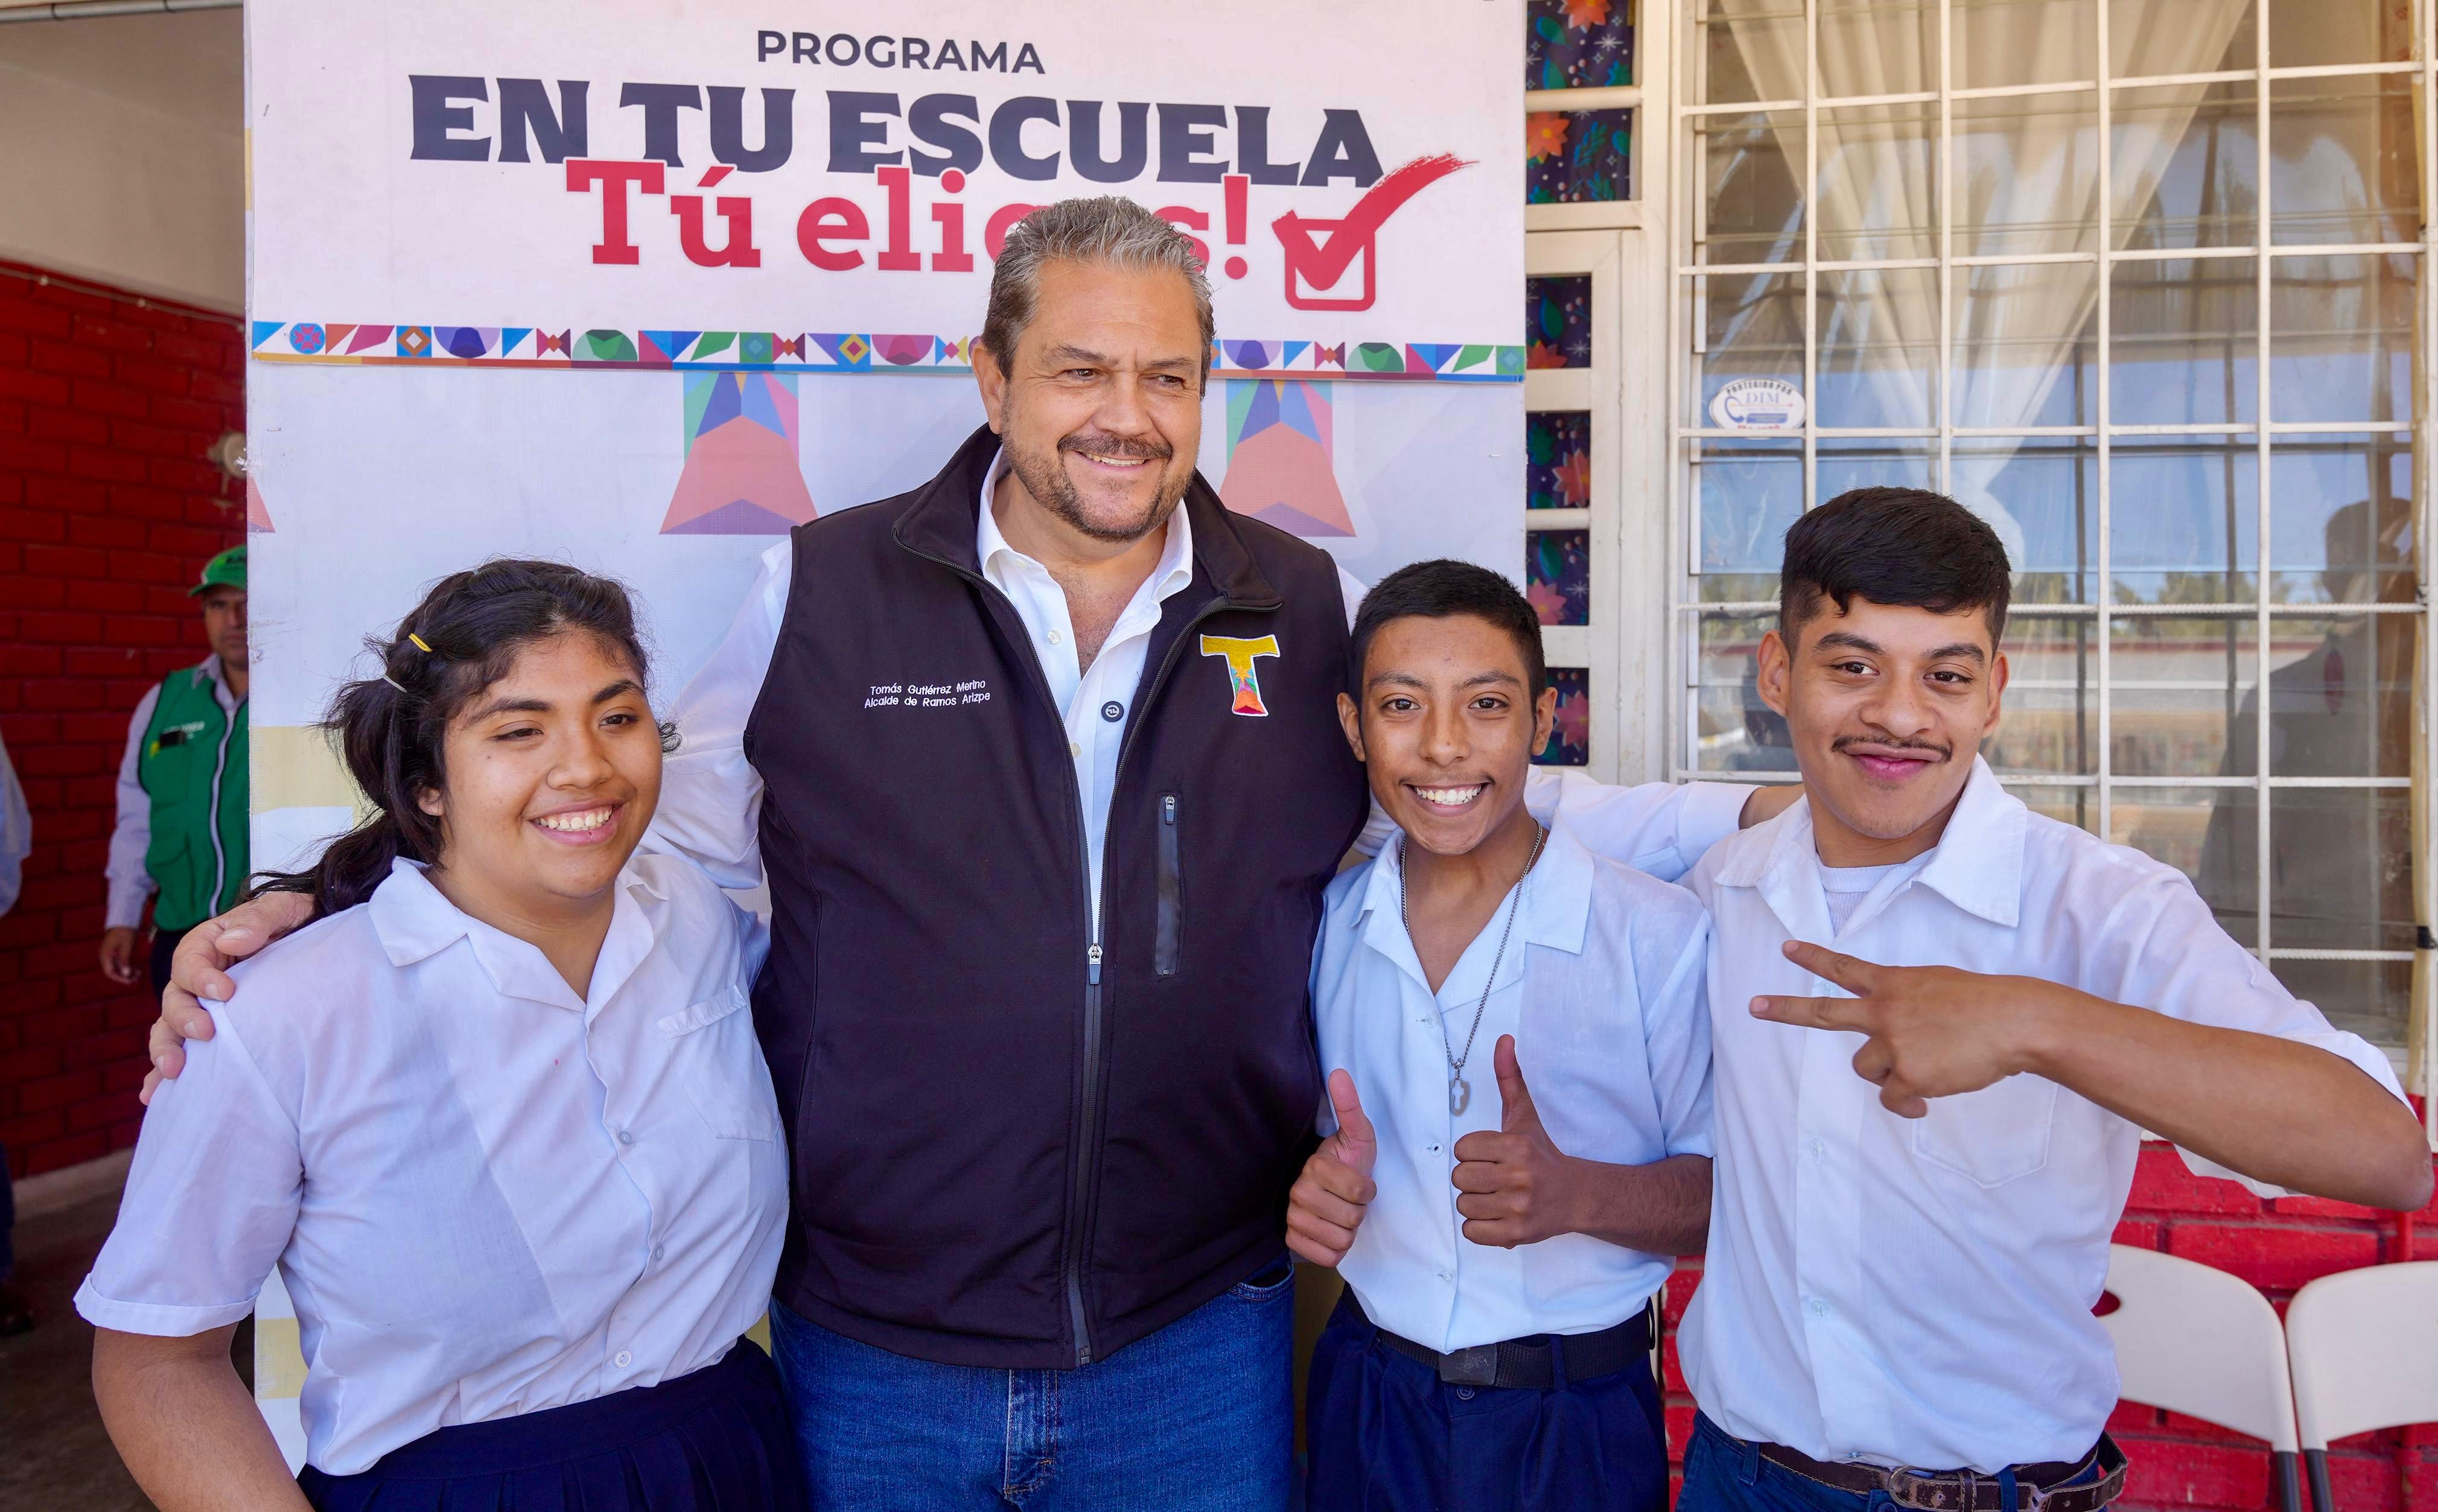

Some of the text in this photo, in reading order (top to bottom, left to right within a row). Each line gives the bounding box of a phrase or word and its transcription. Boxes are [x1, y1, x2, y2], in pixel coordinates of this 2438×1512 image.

[757, 30, 1046, 75] PROGRAMA
[408, 74, 1384, 188] EN TU ESCUELA
[565, 159, 1249, 280] Tú elis!
[864, 691, 991, 709] Alcalde de Ramos Arizpe
[870, 679, 986, 696] Tomás Gutiérrez Merino
[1199, 633, 1281, 717] T
